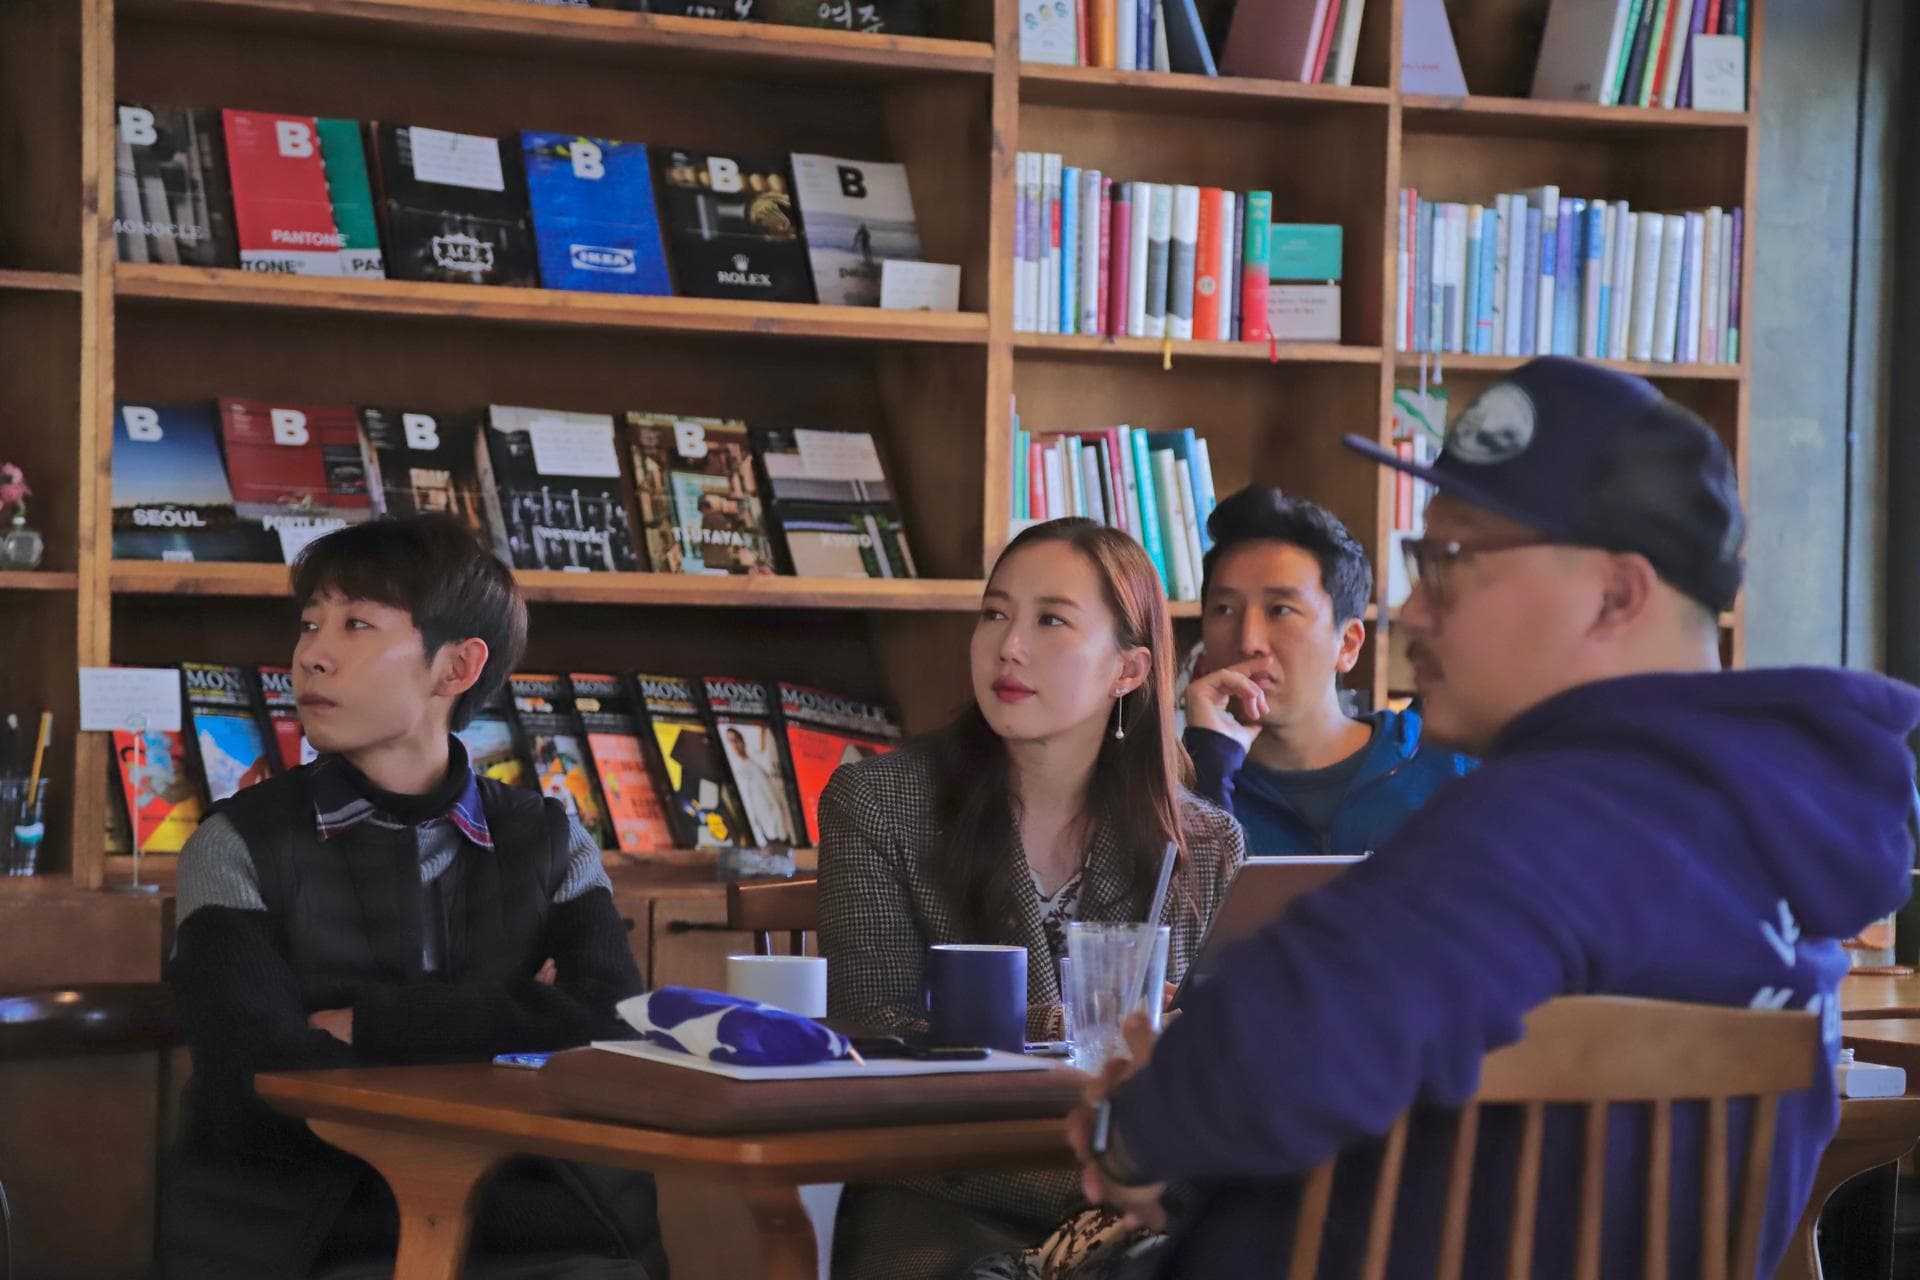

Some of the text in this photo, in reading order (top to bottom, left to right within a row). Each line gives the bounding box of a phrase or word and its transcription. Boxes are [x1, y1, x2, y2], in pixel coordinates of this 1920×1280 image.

[118, 105, 158, 146] B
[275, 120, 314, 158] B
[569, 142, 606, 180] B
[706, 156, 743, 193] B
[837, 164, 868, 198] B
[271, 229, 348, 248] PANTONE
[579, 251, 628, 267] IKEA
[717, 270, 771, 287] ROLEX
[122, 405, 164, 442] B
[270, 408, 310, 446] B
[402, 412, 441, 450] B
[673, 421, 709, 459] B
[132, 508, 207, 528] SEOUL
